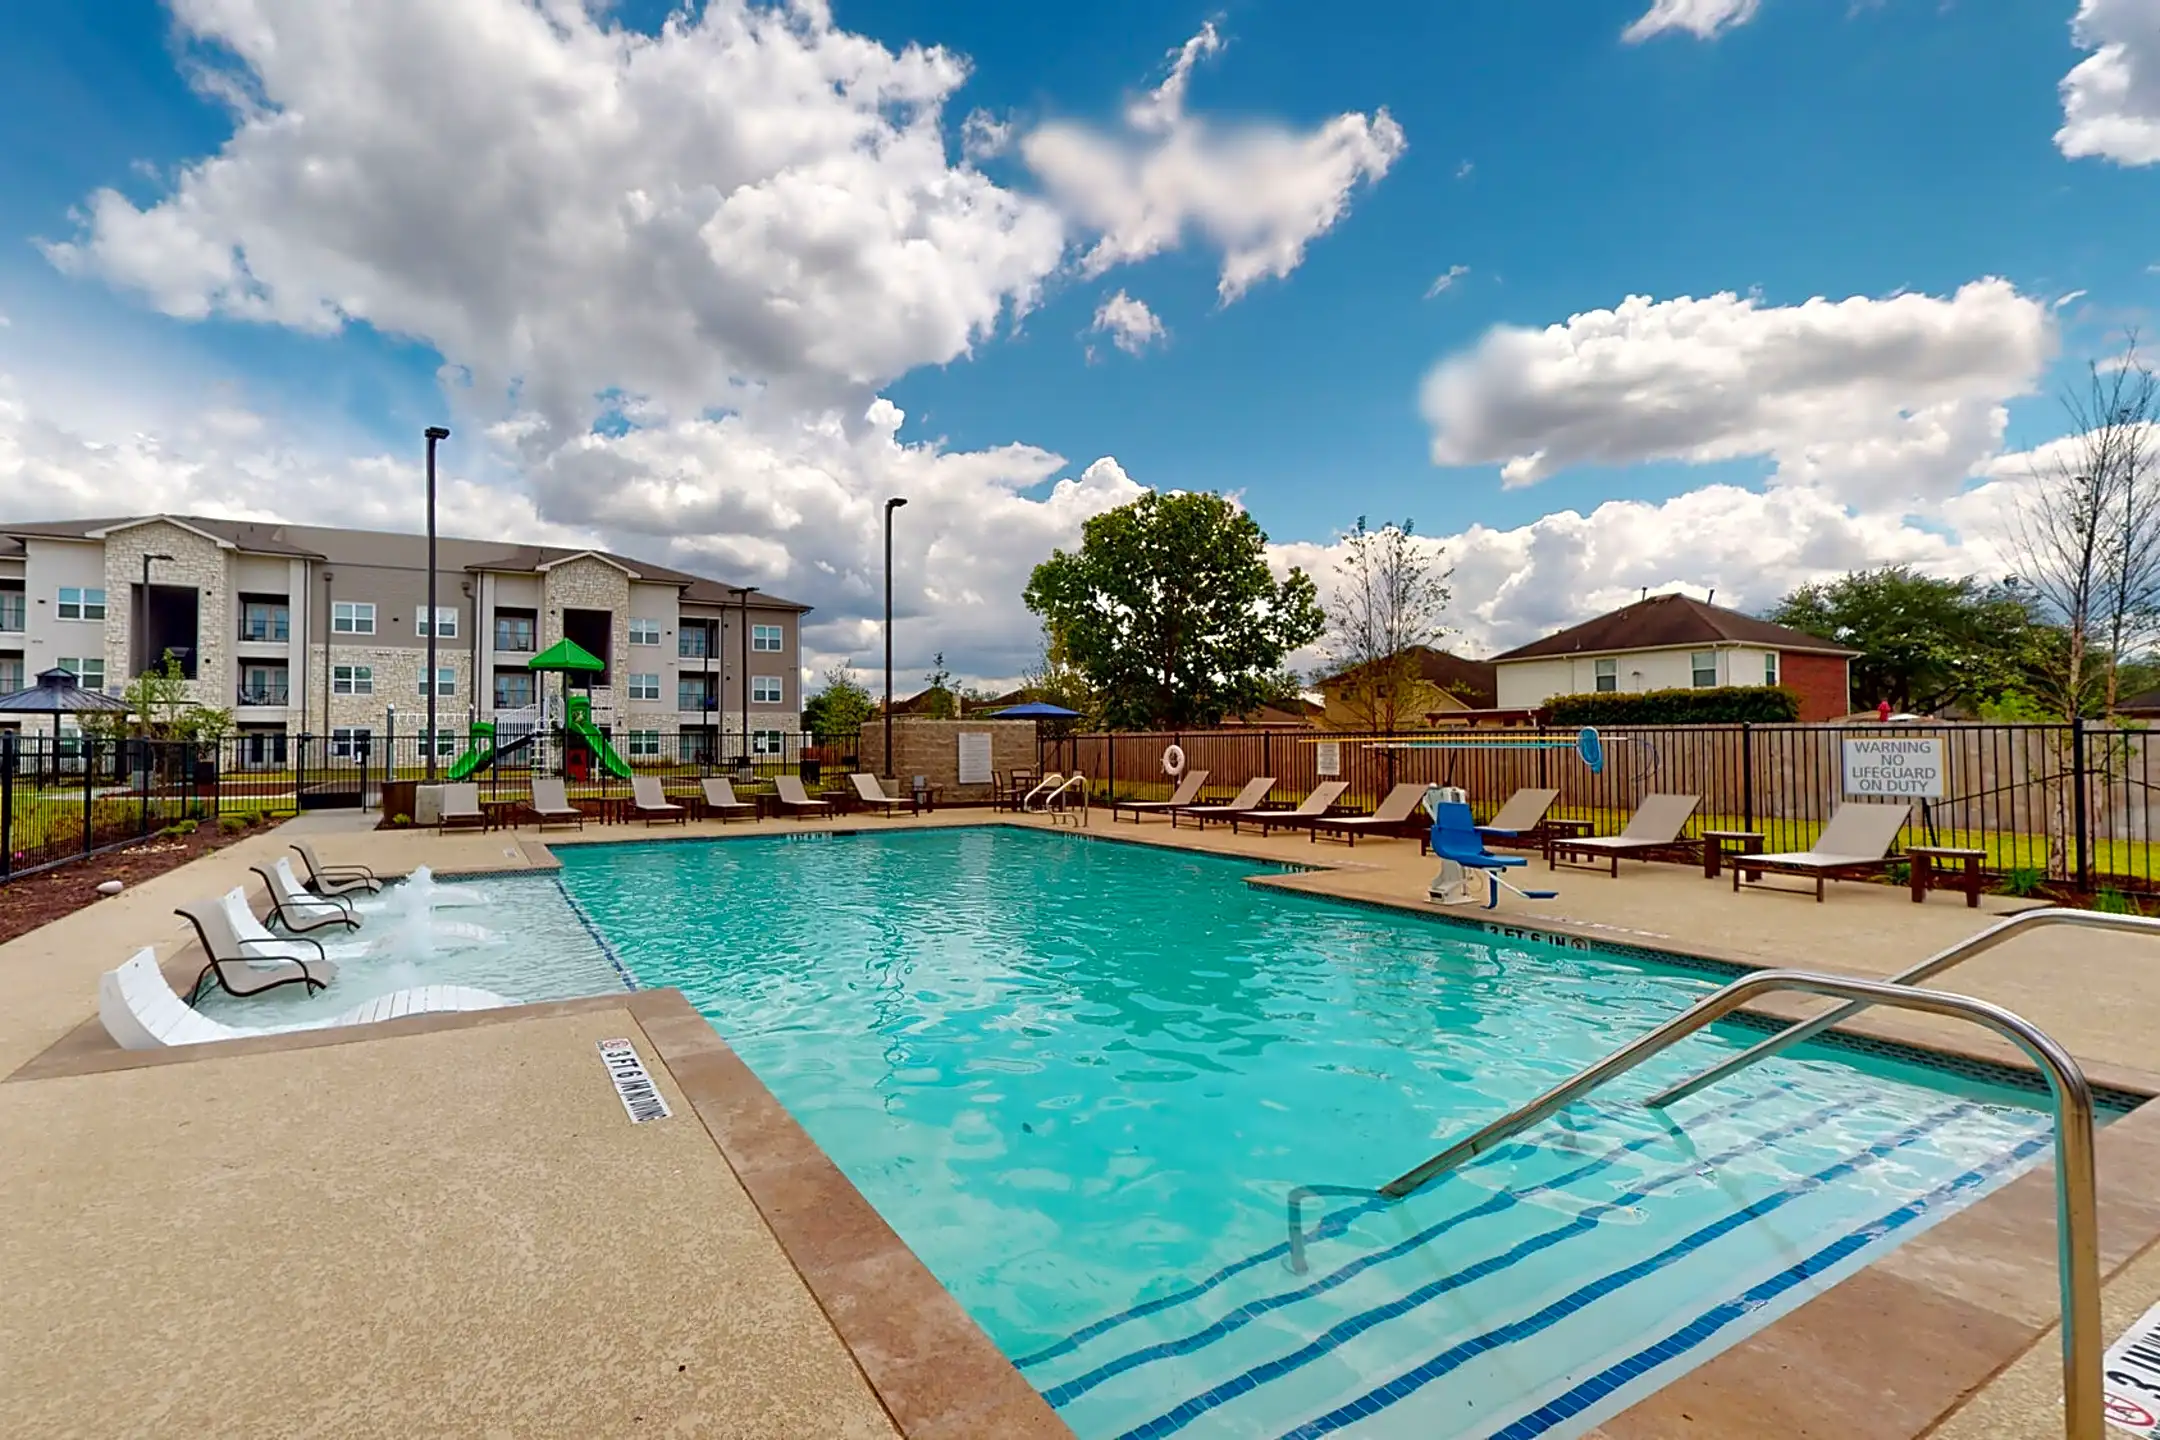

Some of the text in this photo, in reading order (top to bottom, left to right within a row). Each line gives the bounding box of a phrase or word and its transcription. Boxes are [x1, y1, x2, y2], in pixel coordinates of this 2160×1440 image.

[1854, 741, 1932, 753] WARNING
[1881, 754, 1905, 767] NO
[1852, 766, 1936, 780] LIFEGUARD
[1860, 779, 1928, 793] ON DUTY
